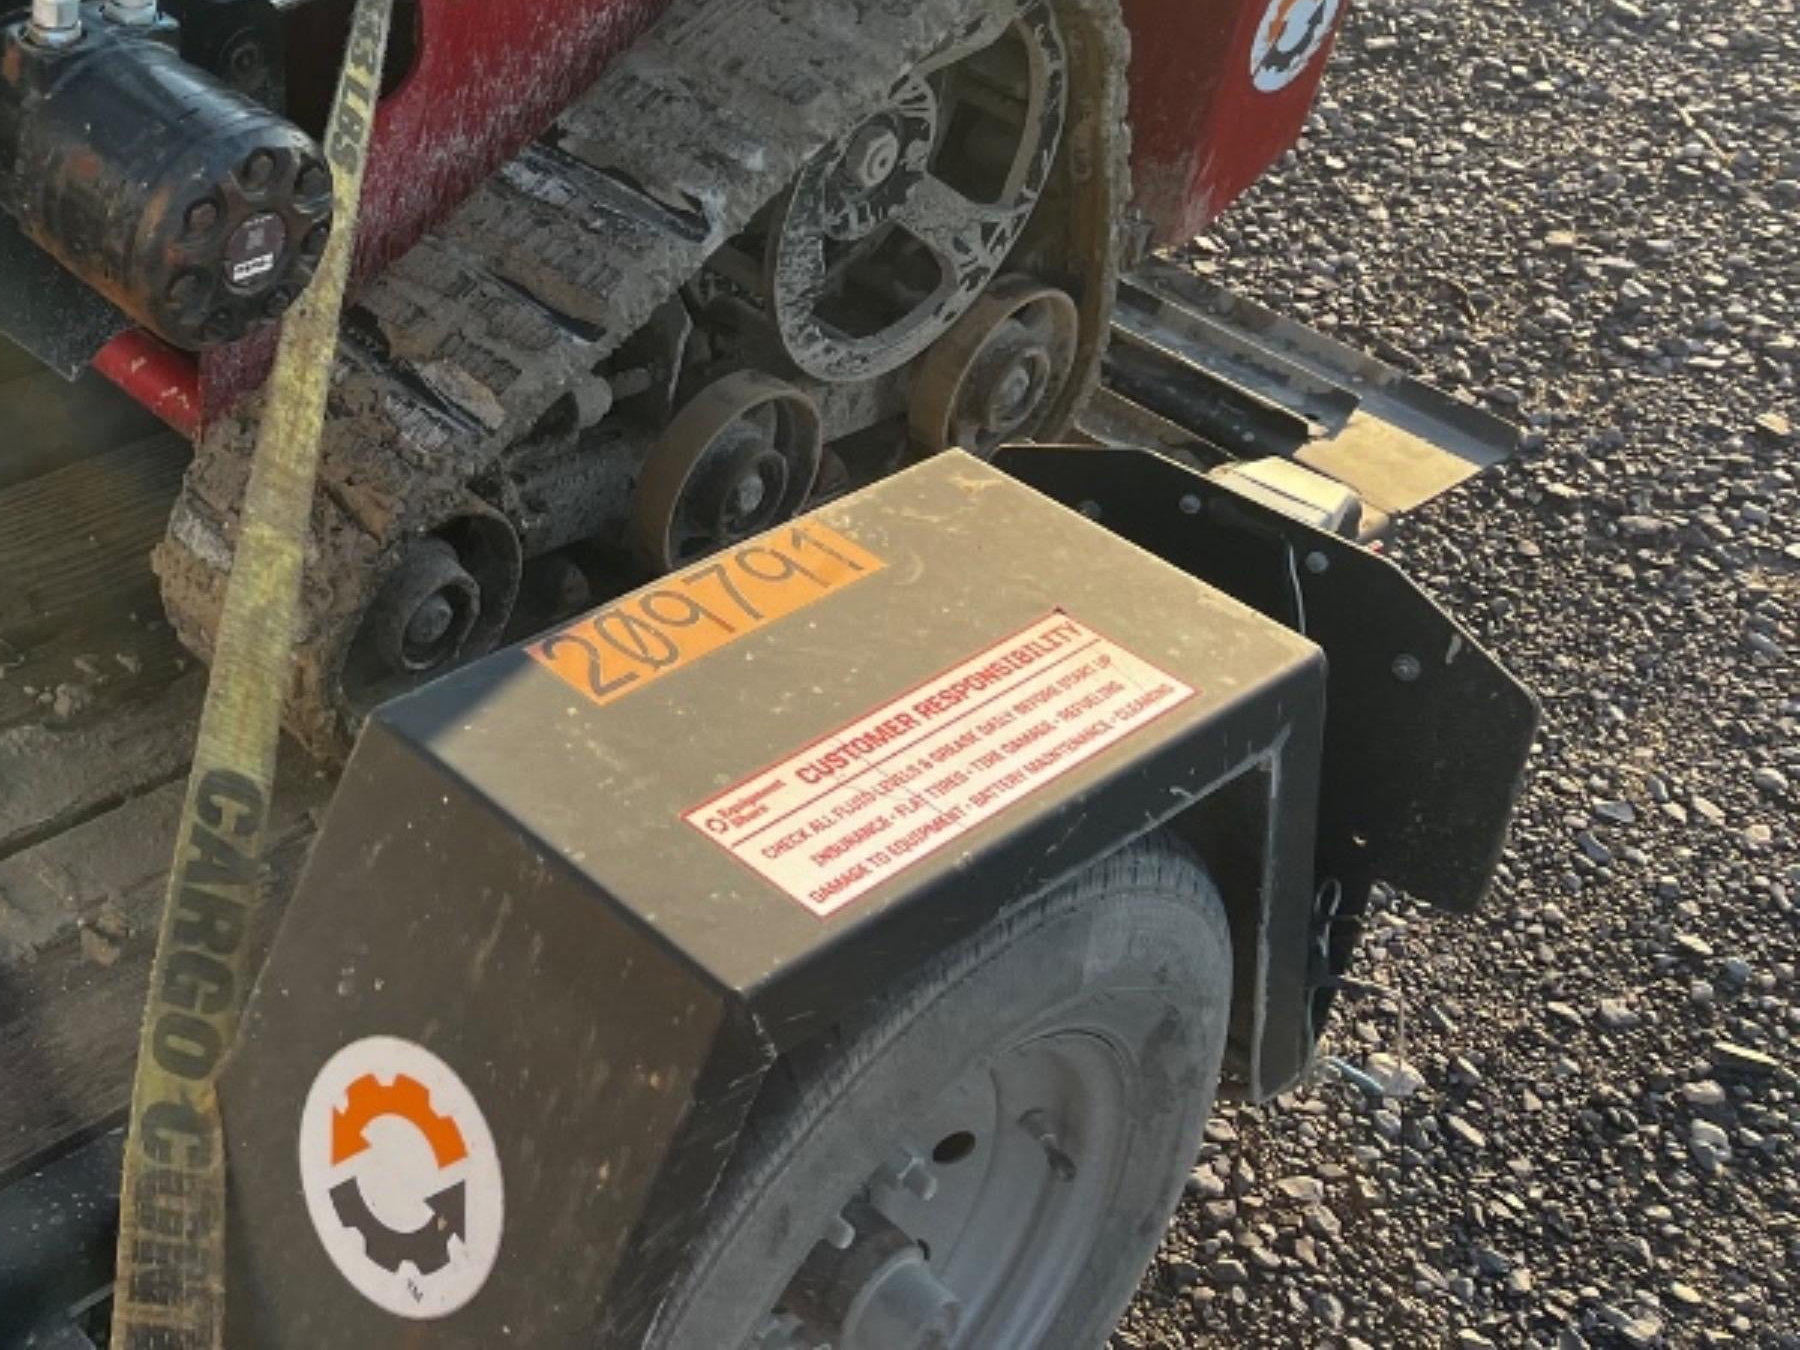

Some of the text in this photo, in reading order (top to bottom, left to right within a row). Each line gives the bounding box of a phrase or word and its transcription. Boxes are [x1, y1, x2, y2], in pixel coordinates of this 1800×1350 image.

[543, 526, 865, 697] 209791
[794, 620, 1081, 785] CUSTOMER RESPONSIBILITY
[760, 827, 813, 859] CHECK
[807, 815, 837, 835] ALL
[830, 790, 877, 820] FLUID
[872, 764, 924, 797] LEVELS
[928, 730, 981, 763] GREASE
[975, 711, 1017, 736] DAILY
[1012, 685, 1063, 715] BEFORE
[1055, 663, 1097, 691] START
[1091, 653, 1113, 670] UP
[808, 683, 1175, 904] DAMAGE TO EQUIPMENT BATTERY MAINTENANCE CLEANING
[810, 680, 1125, 867] INSURANCE FLAT TIRES TIRE DAMAGE REFUELING
[152, 769, 264, 1081] CARGO
